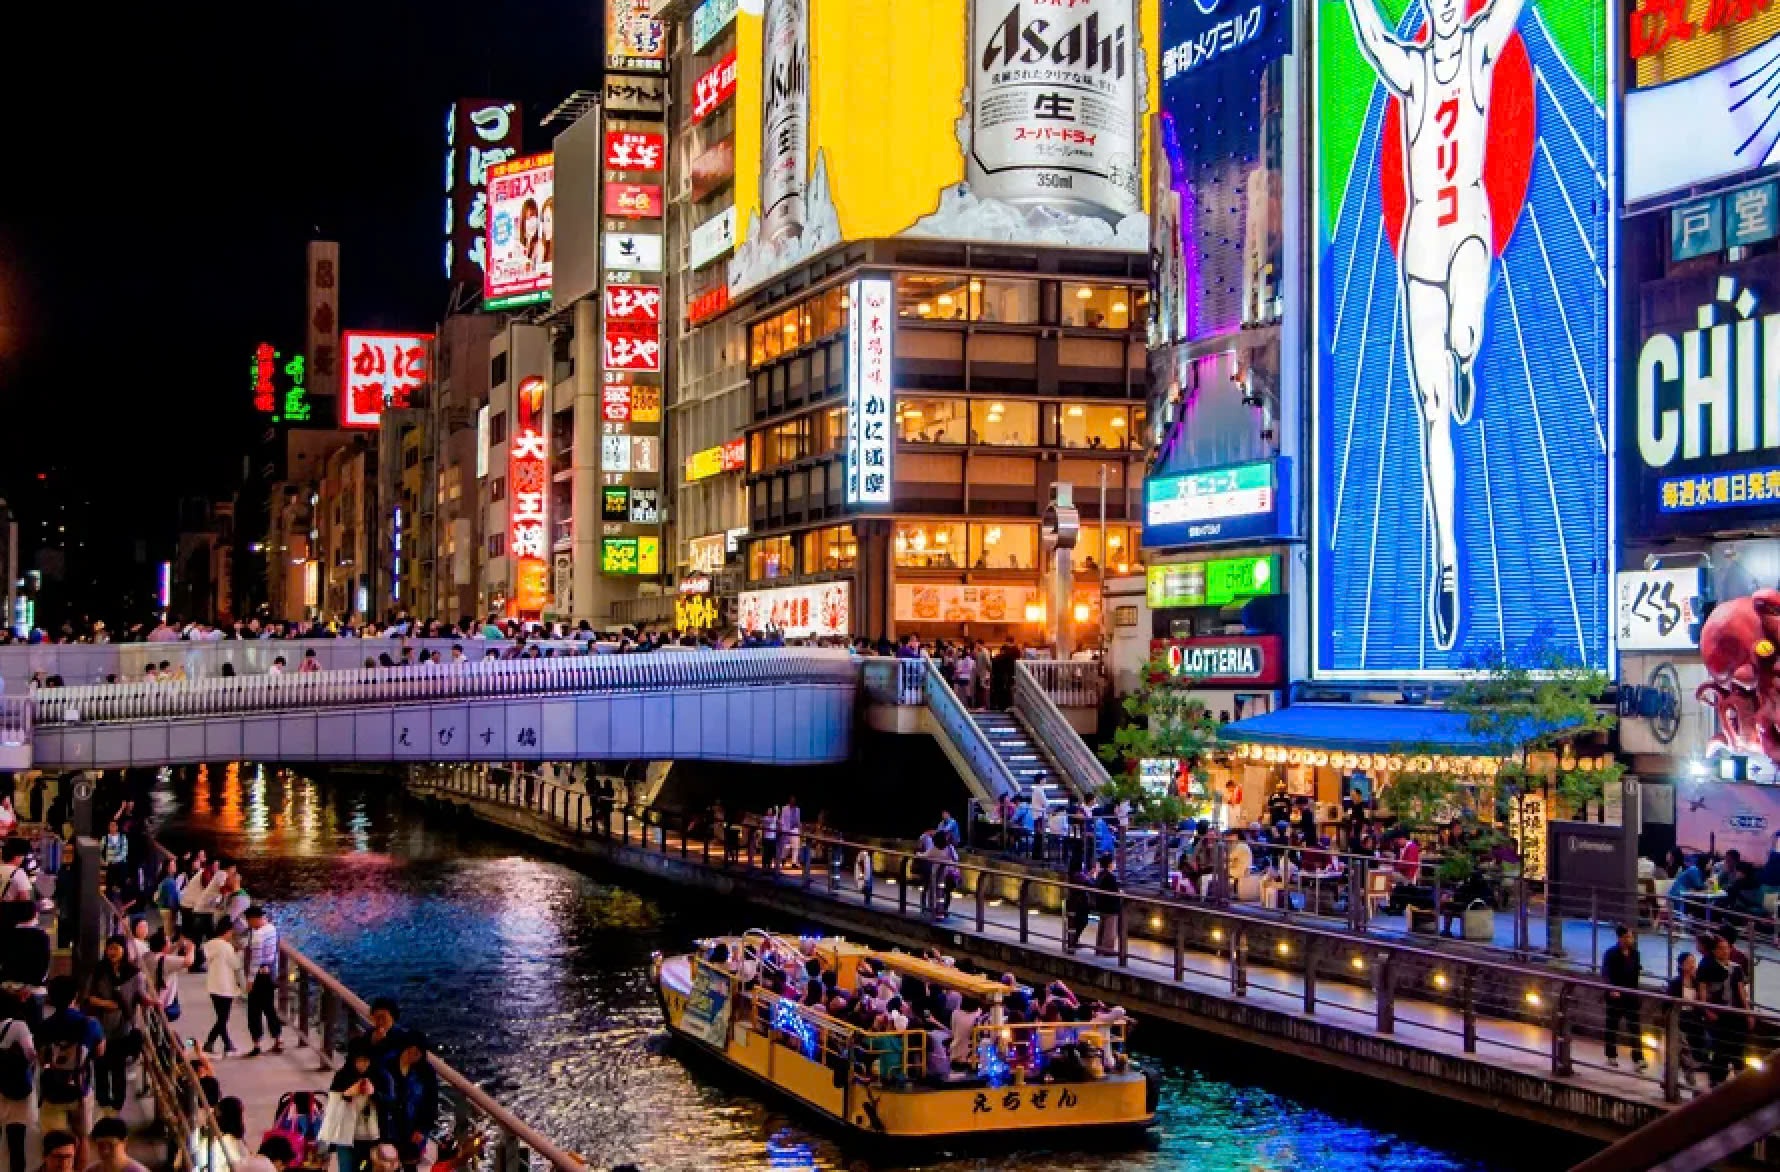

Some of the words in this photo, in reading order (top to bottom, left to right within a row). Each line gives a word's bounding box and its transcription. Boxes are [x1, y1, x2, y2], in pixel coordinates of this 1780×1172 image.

[982, 3, 1125, 80] Asahi
[1034, 92, 1075, 121] 生
[1013, 127, 1097, 146] スーパードライ
[1434, 87, 1461, 228] グリコ
[1037, 173, 1073, 188] 350ml
[606, 288, 661, 318] はや
[352, 342, 427, 378] かに
[606, 337, 660, 367] はや
[1183, 647, 1254, 673] LOTTERIA
[398, 727, 537, 747] えびす橋
[970, 1086, 1080, 1115] えちぜん
